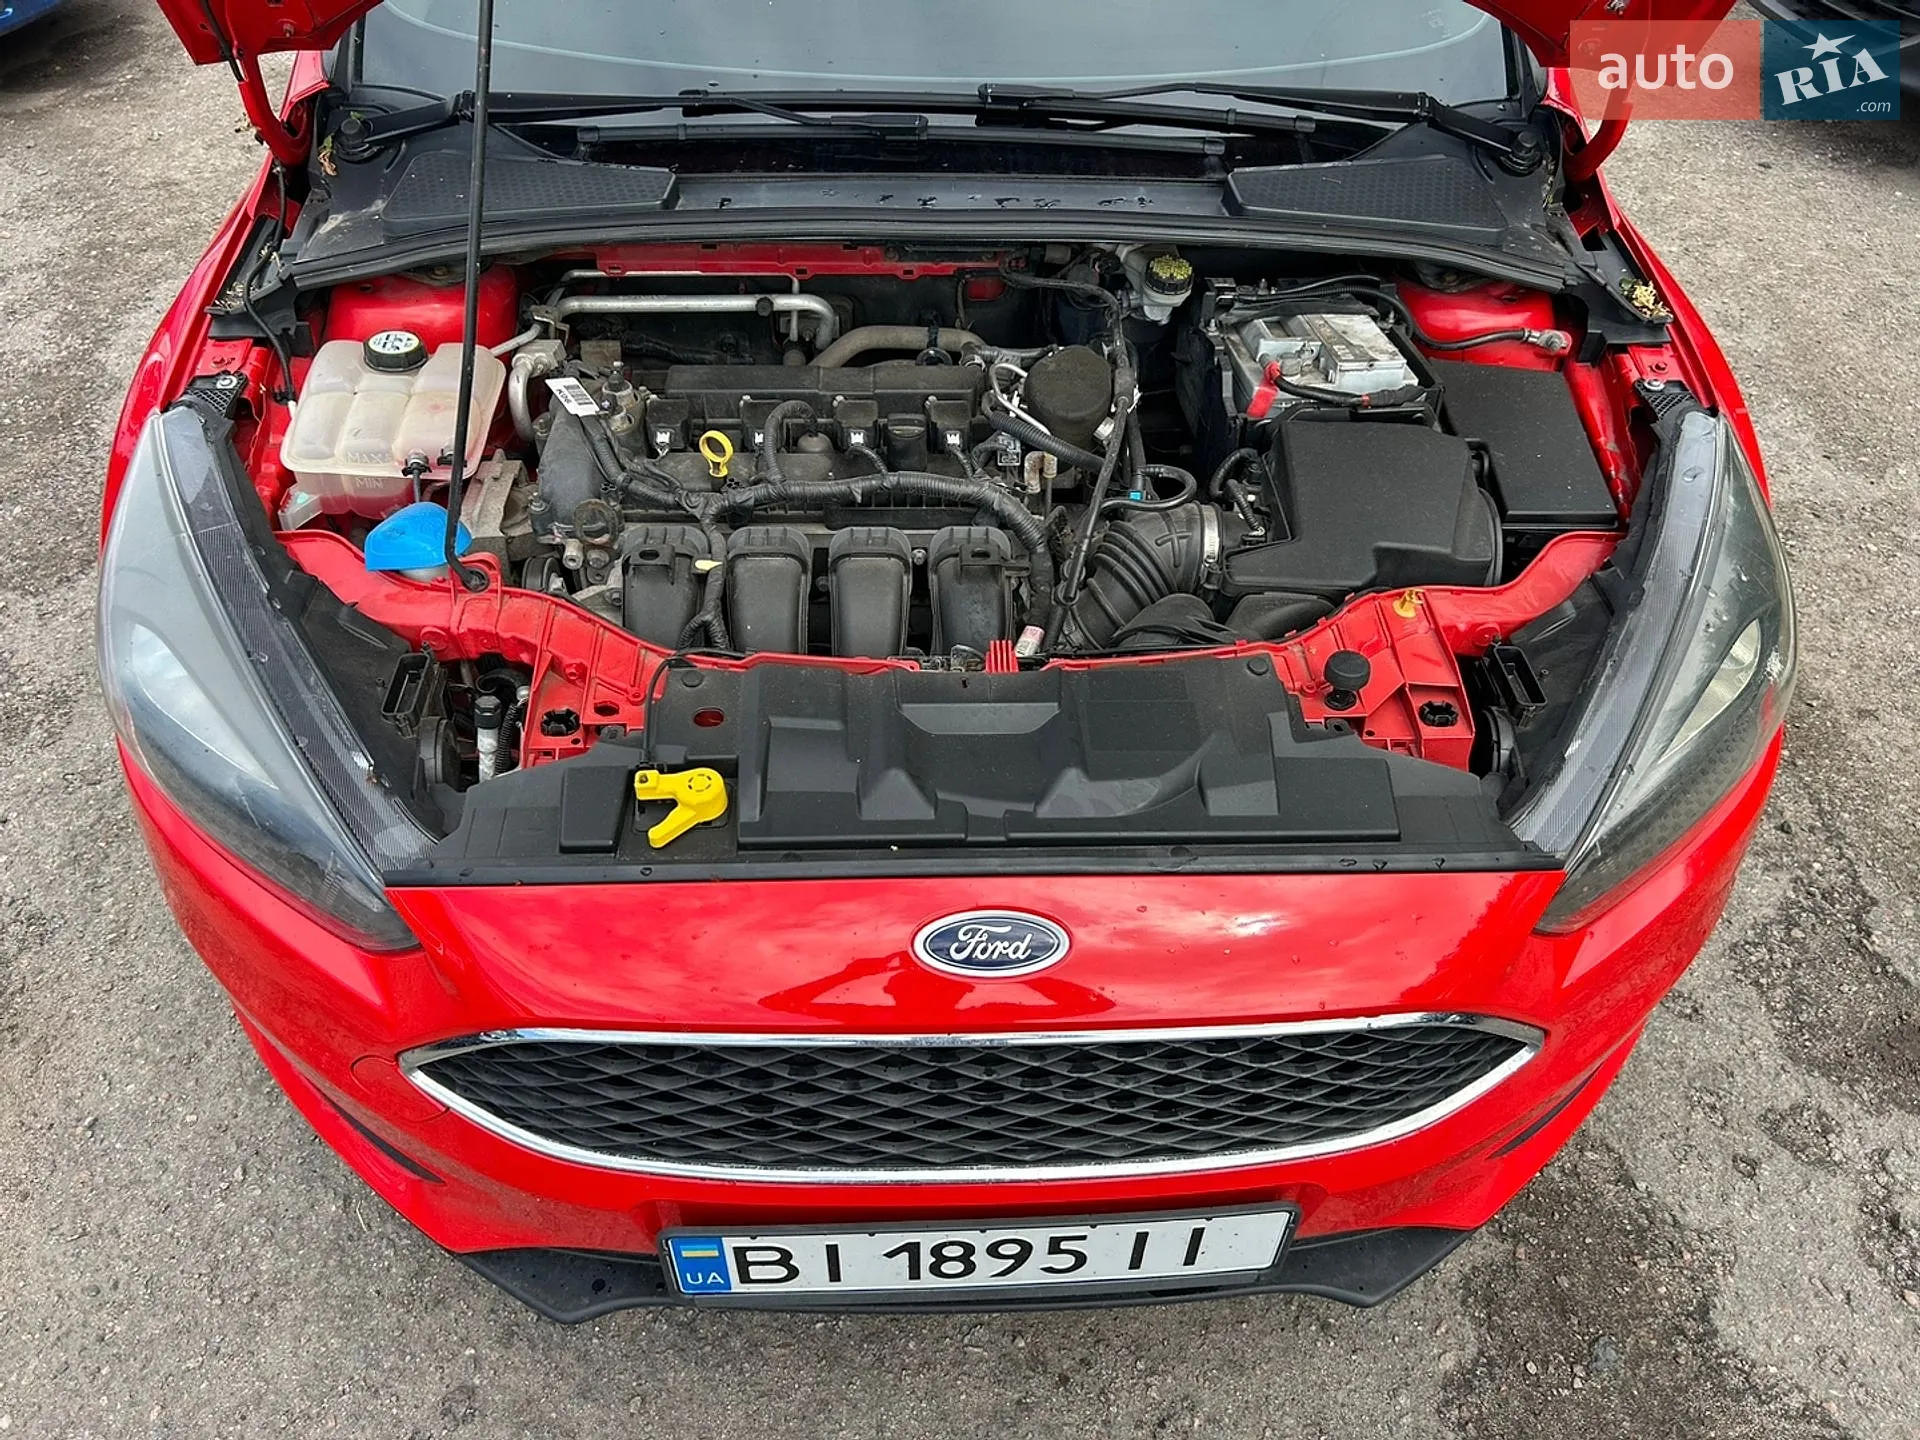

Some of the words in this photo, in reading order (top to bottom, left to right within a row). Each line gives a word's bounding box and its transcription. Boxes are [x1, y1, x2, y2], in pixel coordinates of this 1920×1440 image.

[355, 477, 384, 488] MIN
[949, 924, 1033, 961] Ford
[881, 1234, 1089, 1282] 1895
[686, 1271, 725, 1285] UA
